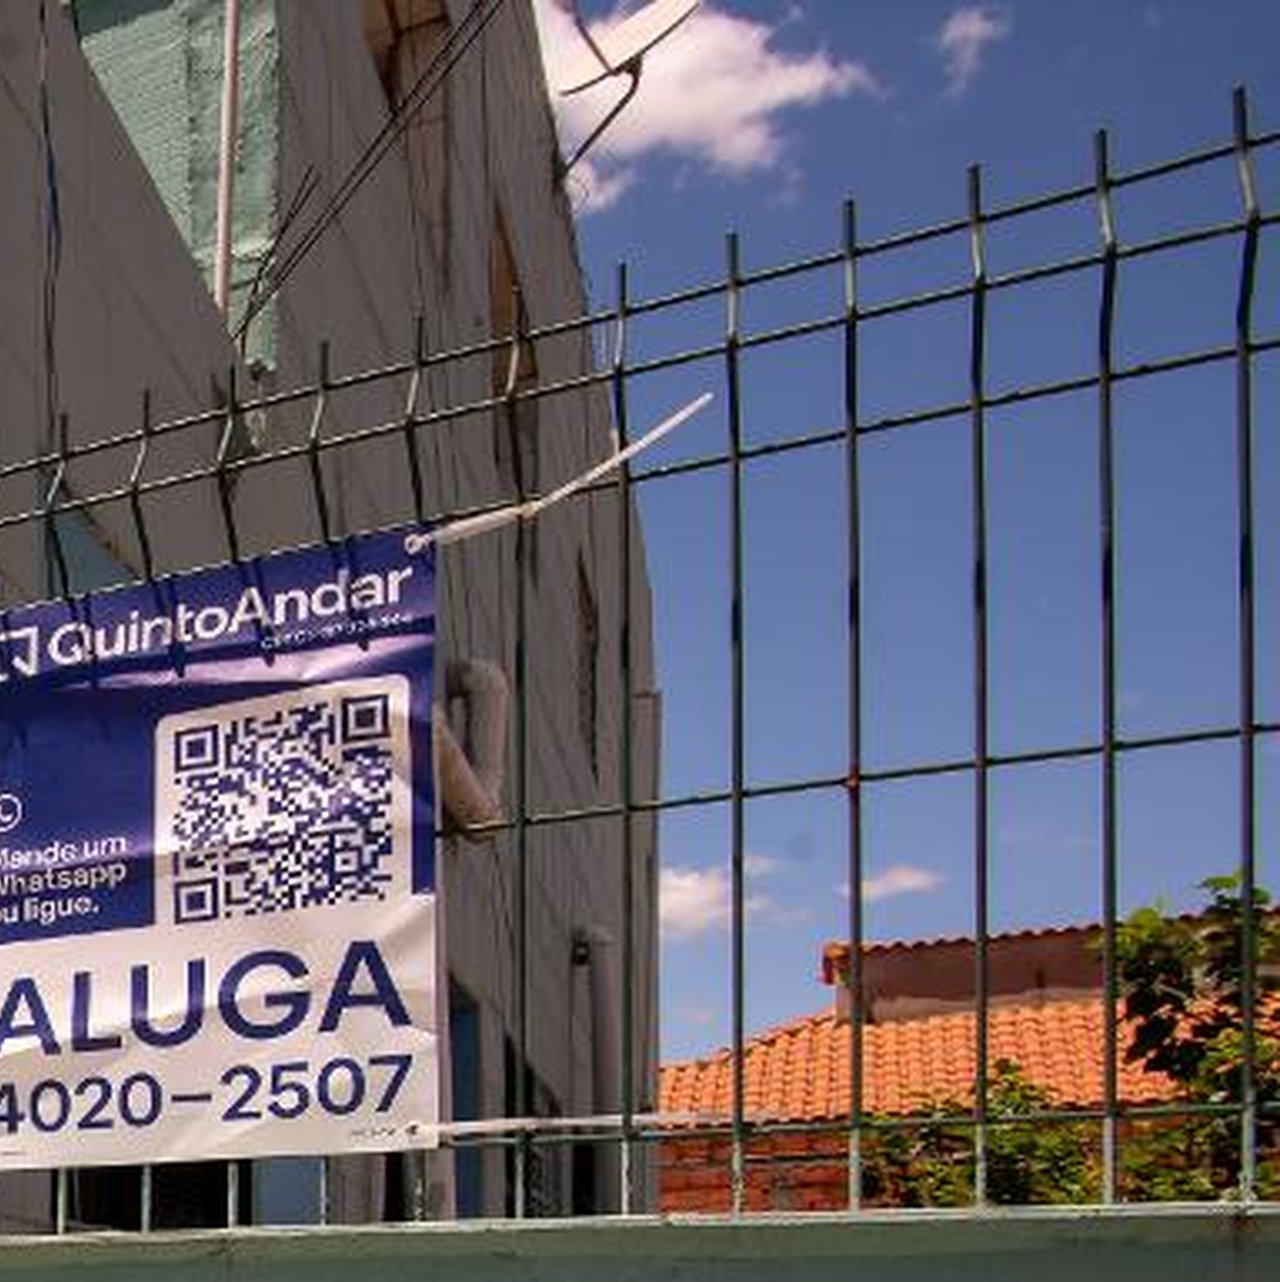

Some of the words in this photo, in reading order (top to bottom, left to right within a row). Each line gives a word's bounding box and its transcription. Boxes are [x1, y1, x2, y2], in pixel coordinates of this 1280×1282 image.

[47, 567, 414, 668] QuintoAndar
[83, 836, 127, 857] um
[22, 896, 100, 925] ligue.
